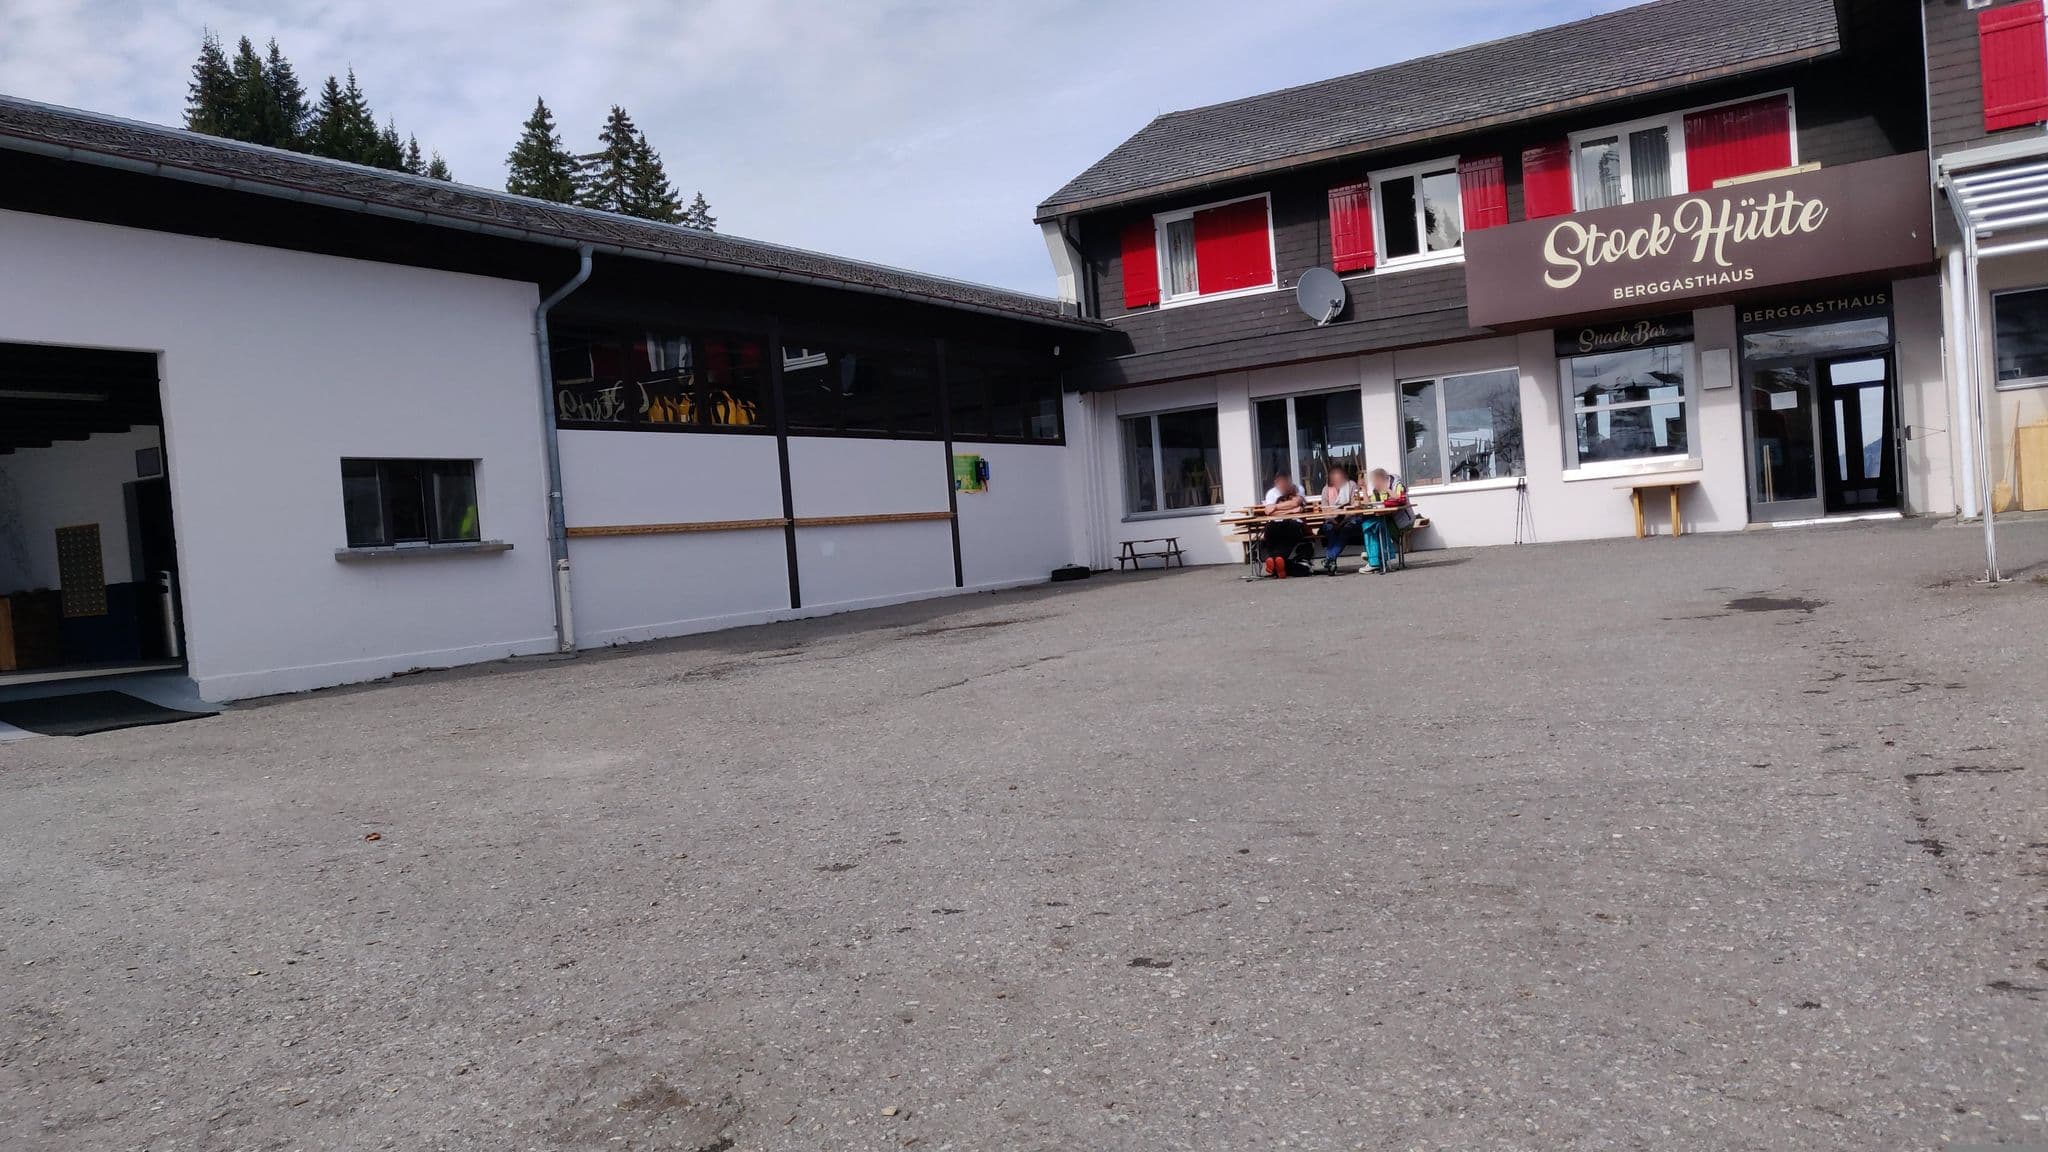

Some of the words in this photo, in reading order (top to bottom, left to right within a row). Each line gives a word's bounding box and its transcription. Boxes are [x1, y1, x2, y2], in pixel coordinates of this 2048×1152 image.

[1544, 212, 1678, 289] Stock
[1673, 190, 1828, 267] Hütte
[1613, 267, 1755, 300] BERGGASTHAUS
[1742, 292, 1888, 323] BERGGASTHAUS
[1578, 326, 1629, 353] Snack
[1630, 320, 1671, 345] Bar
